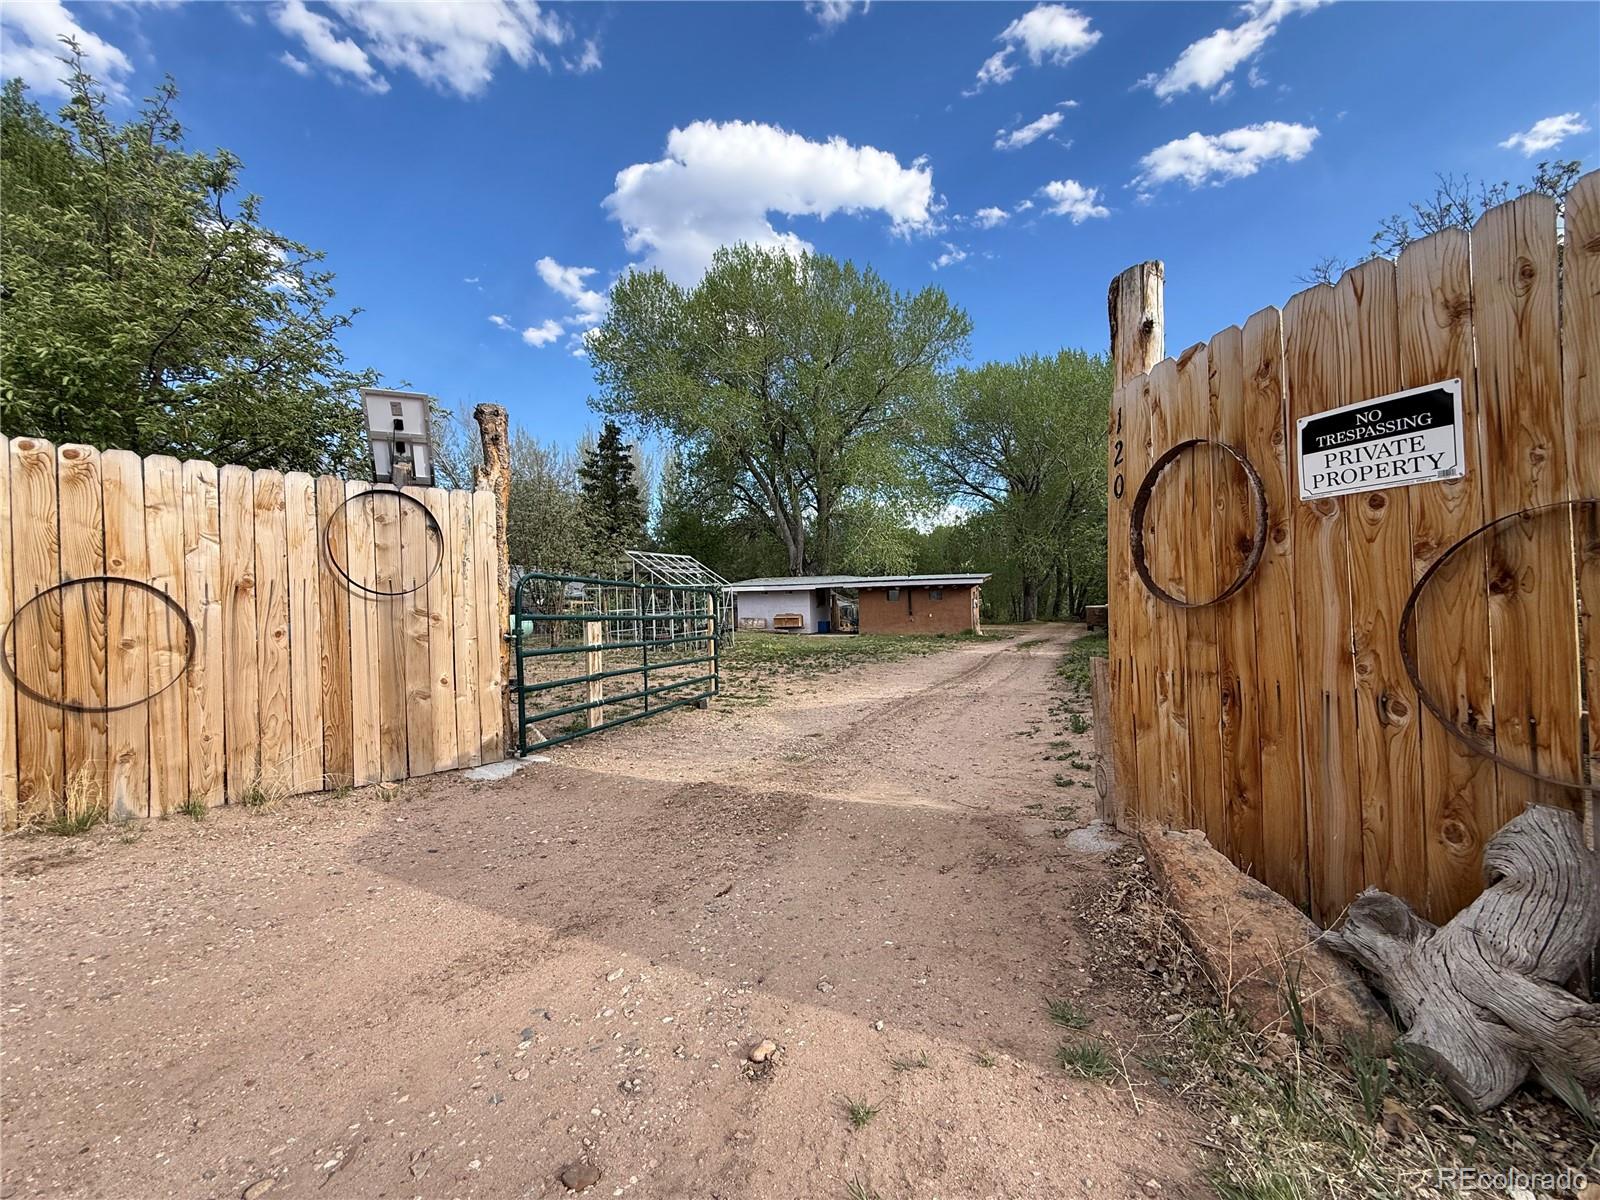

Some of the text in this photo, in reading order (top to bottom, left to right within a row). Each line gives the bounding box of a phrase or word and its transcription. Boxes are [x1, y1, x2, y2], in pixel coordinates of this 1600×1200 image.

[1315, 412, 1433, 448] TRESPASSING
[1355, 409, 1382, 426] NO
[1113, 406, 1125, 499] 120
[1324, 434, 1426, 469] PRIVATE
[1312, 451, 1446, 490] PROPERTY
